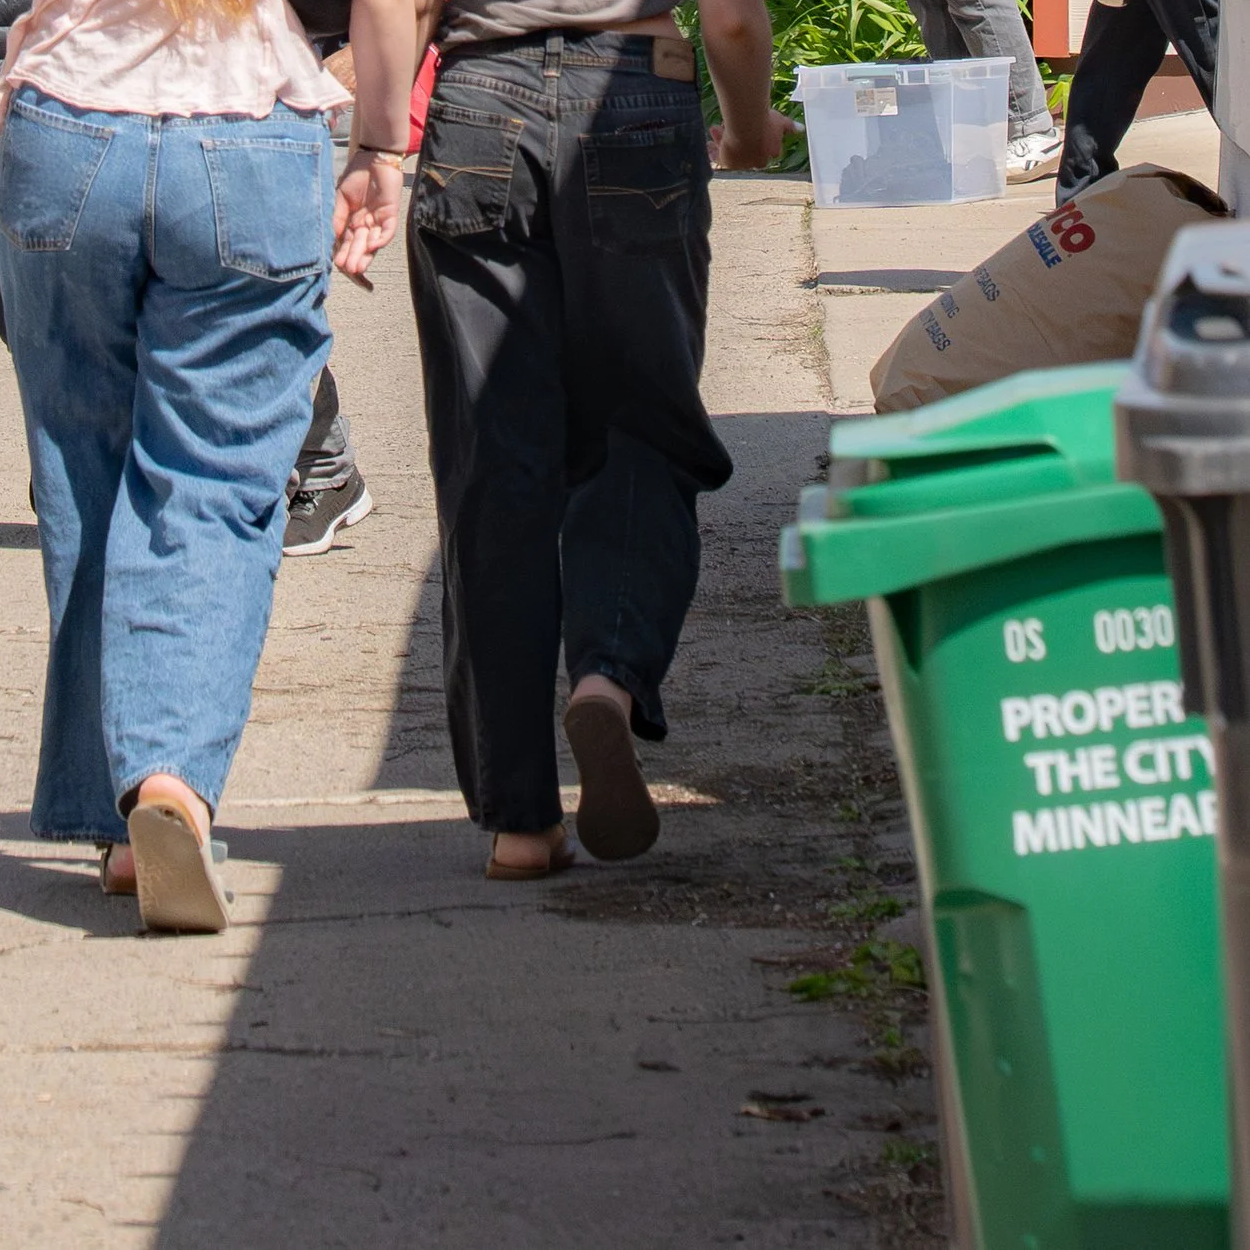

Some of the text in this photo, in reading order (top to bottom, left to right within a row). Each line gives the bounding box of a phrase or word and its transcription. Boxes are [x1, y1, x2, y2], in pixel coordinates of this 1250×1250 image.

[1093, 604, 1176, 655] 0030
[1001, 680, 1186, 743] PROPER
[1023, 743, 1121, 797] THE
